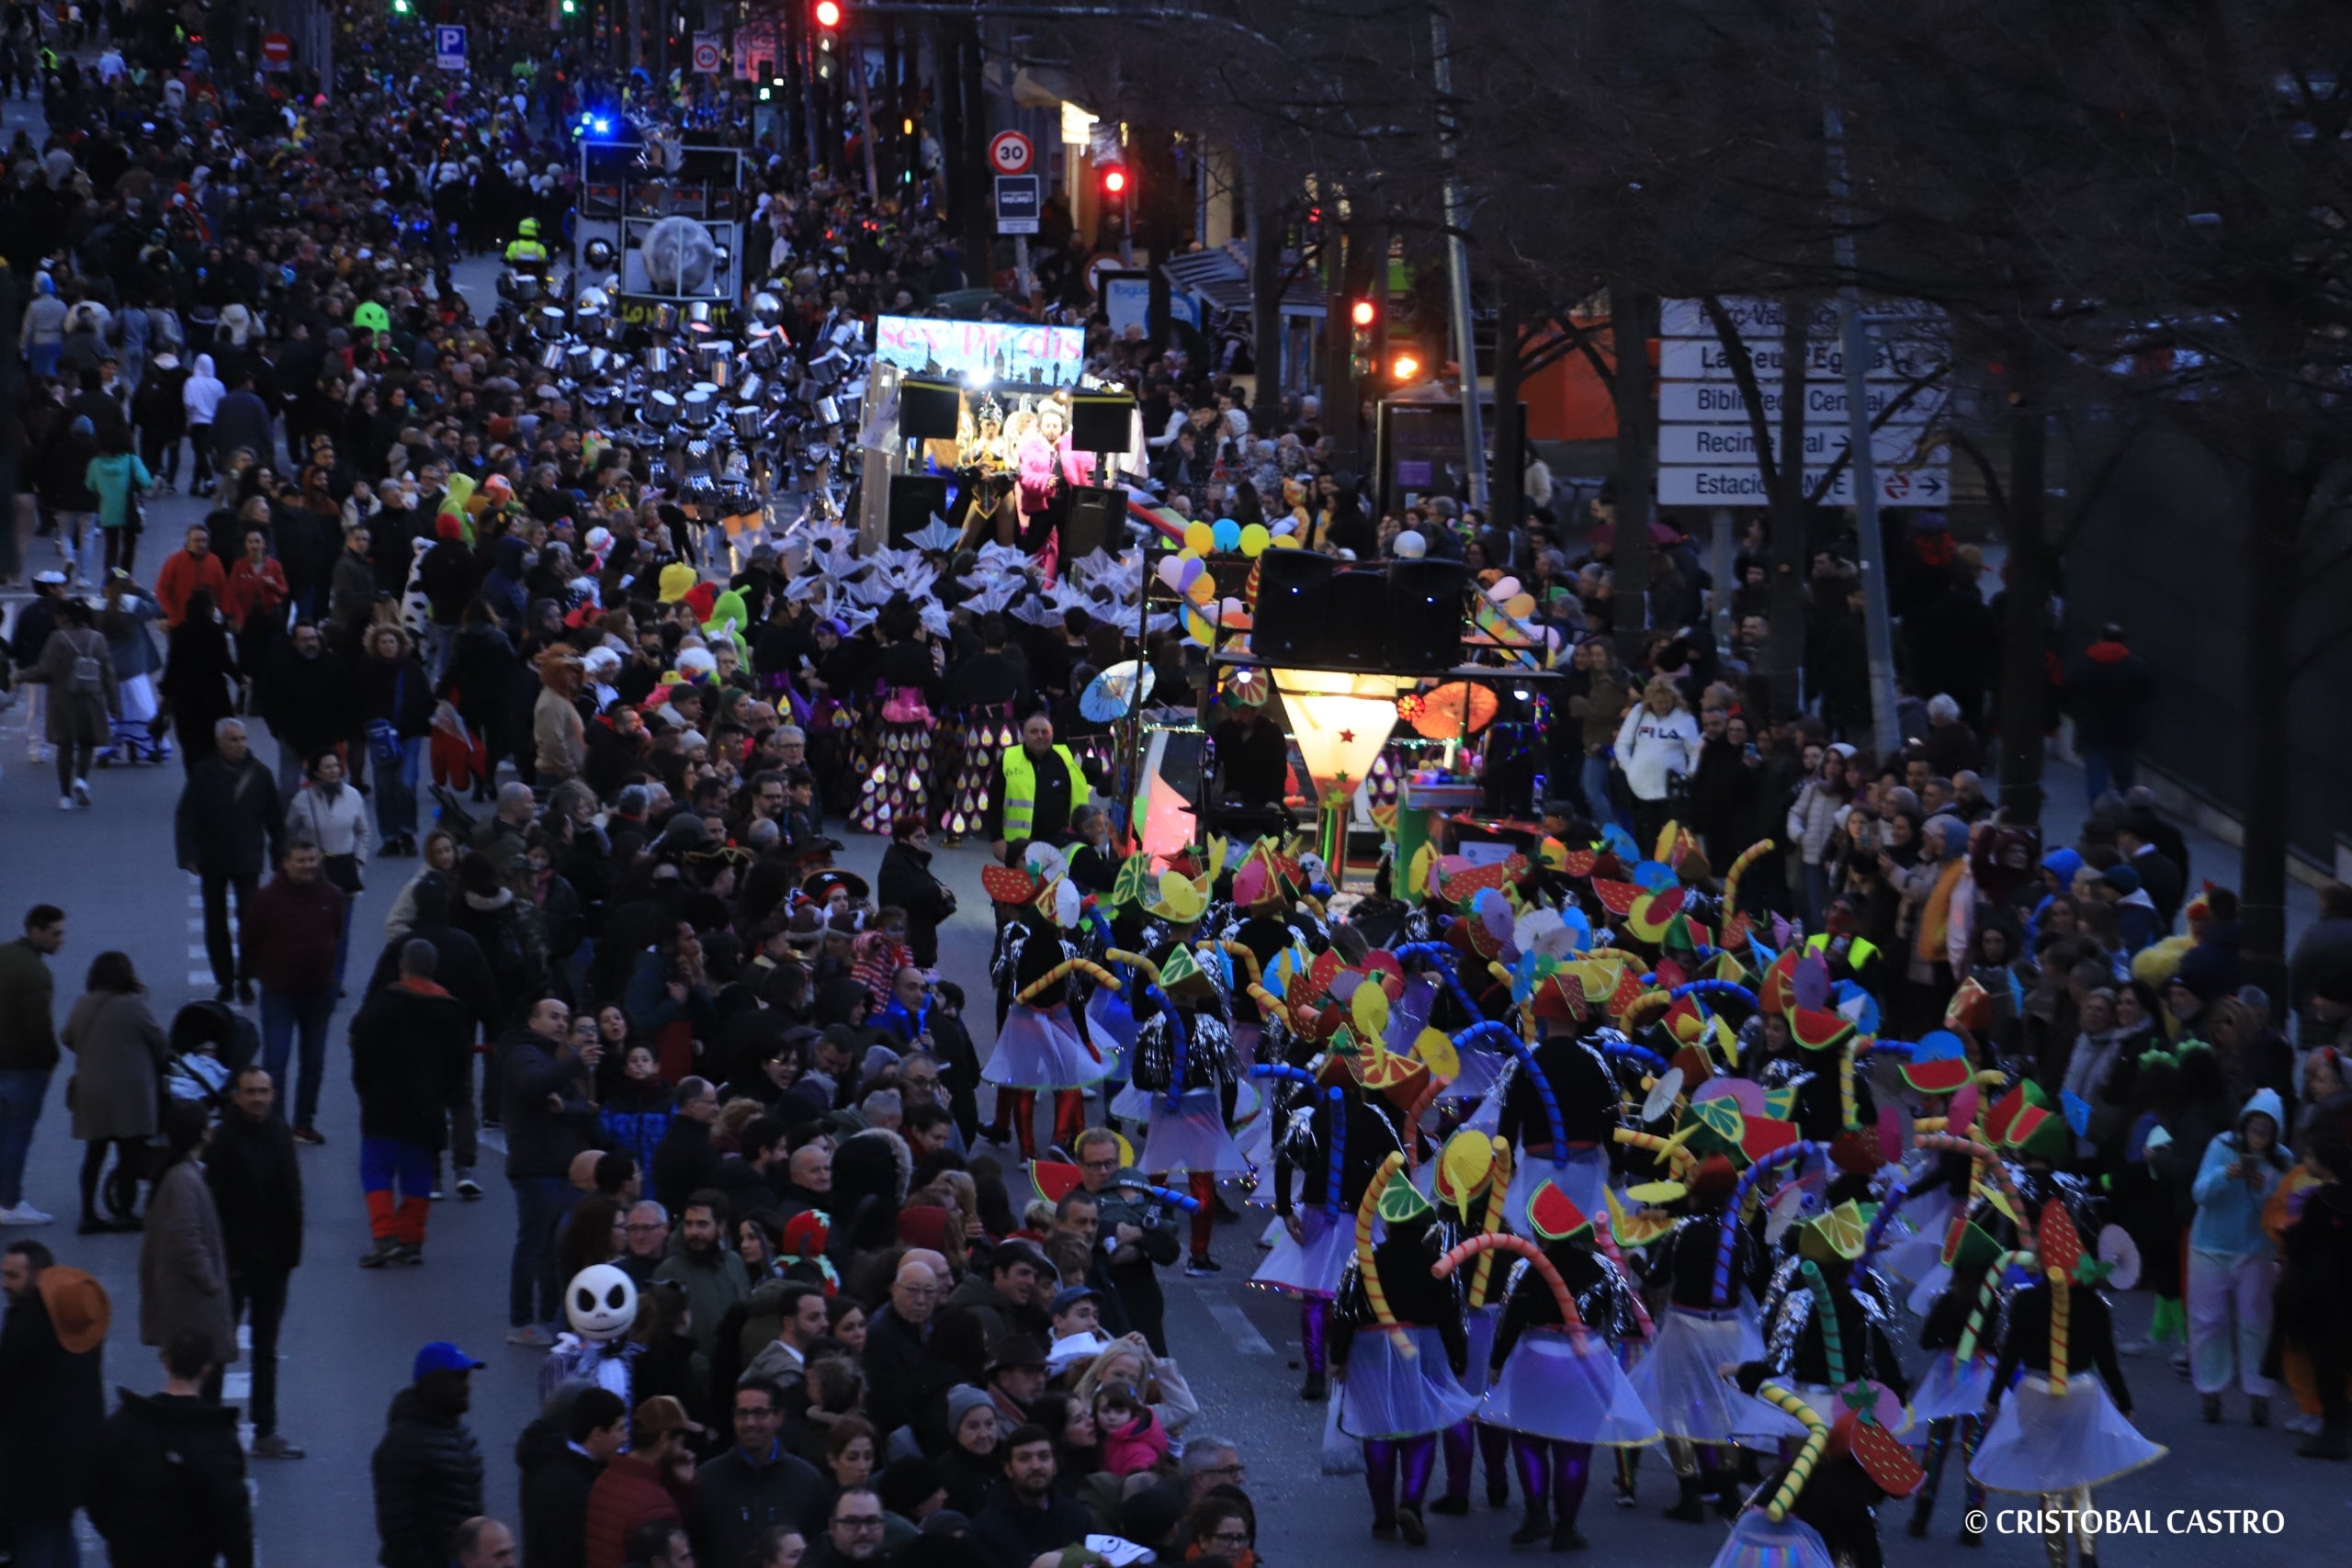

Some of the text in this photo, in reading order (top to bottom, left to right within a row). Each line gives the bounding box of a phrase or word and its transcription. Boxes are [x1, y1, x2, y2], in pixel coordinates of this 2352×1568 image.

[441, 29, 460, 52] P
[1000, 146, 1023, 160] 30
[1702, 346, 1728, 368] La
[1637, 726, 1679, 740] FILA
